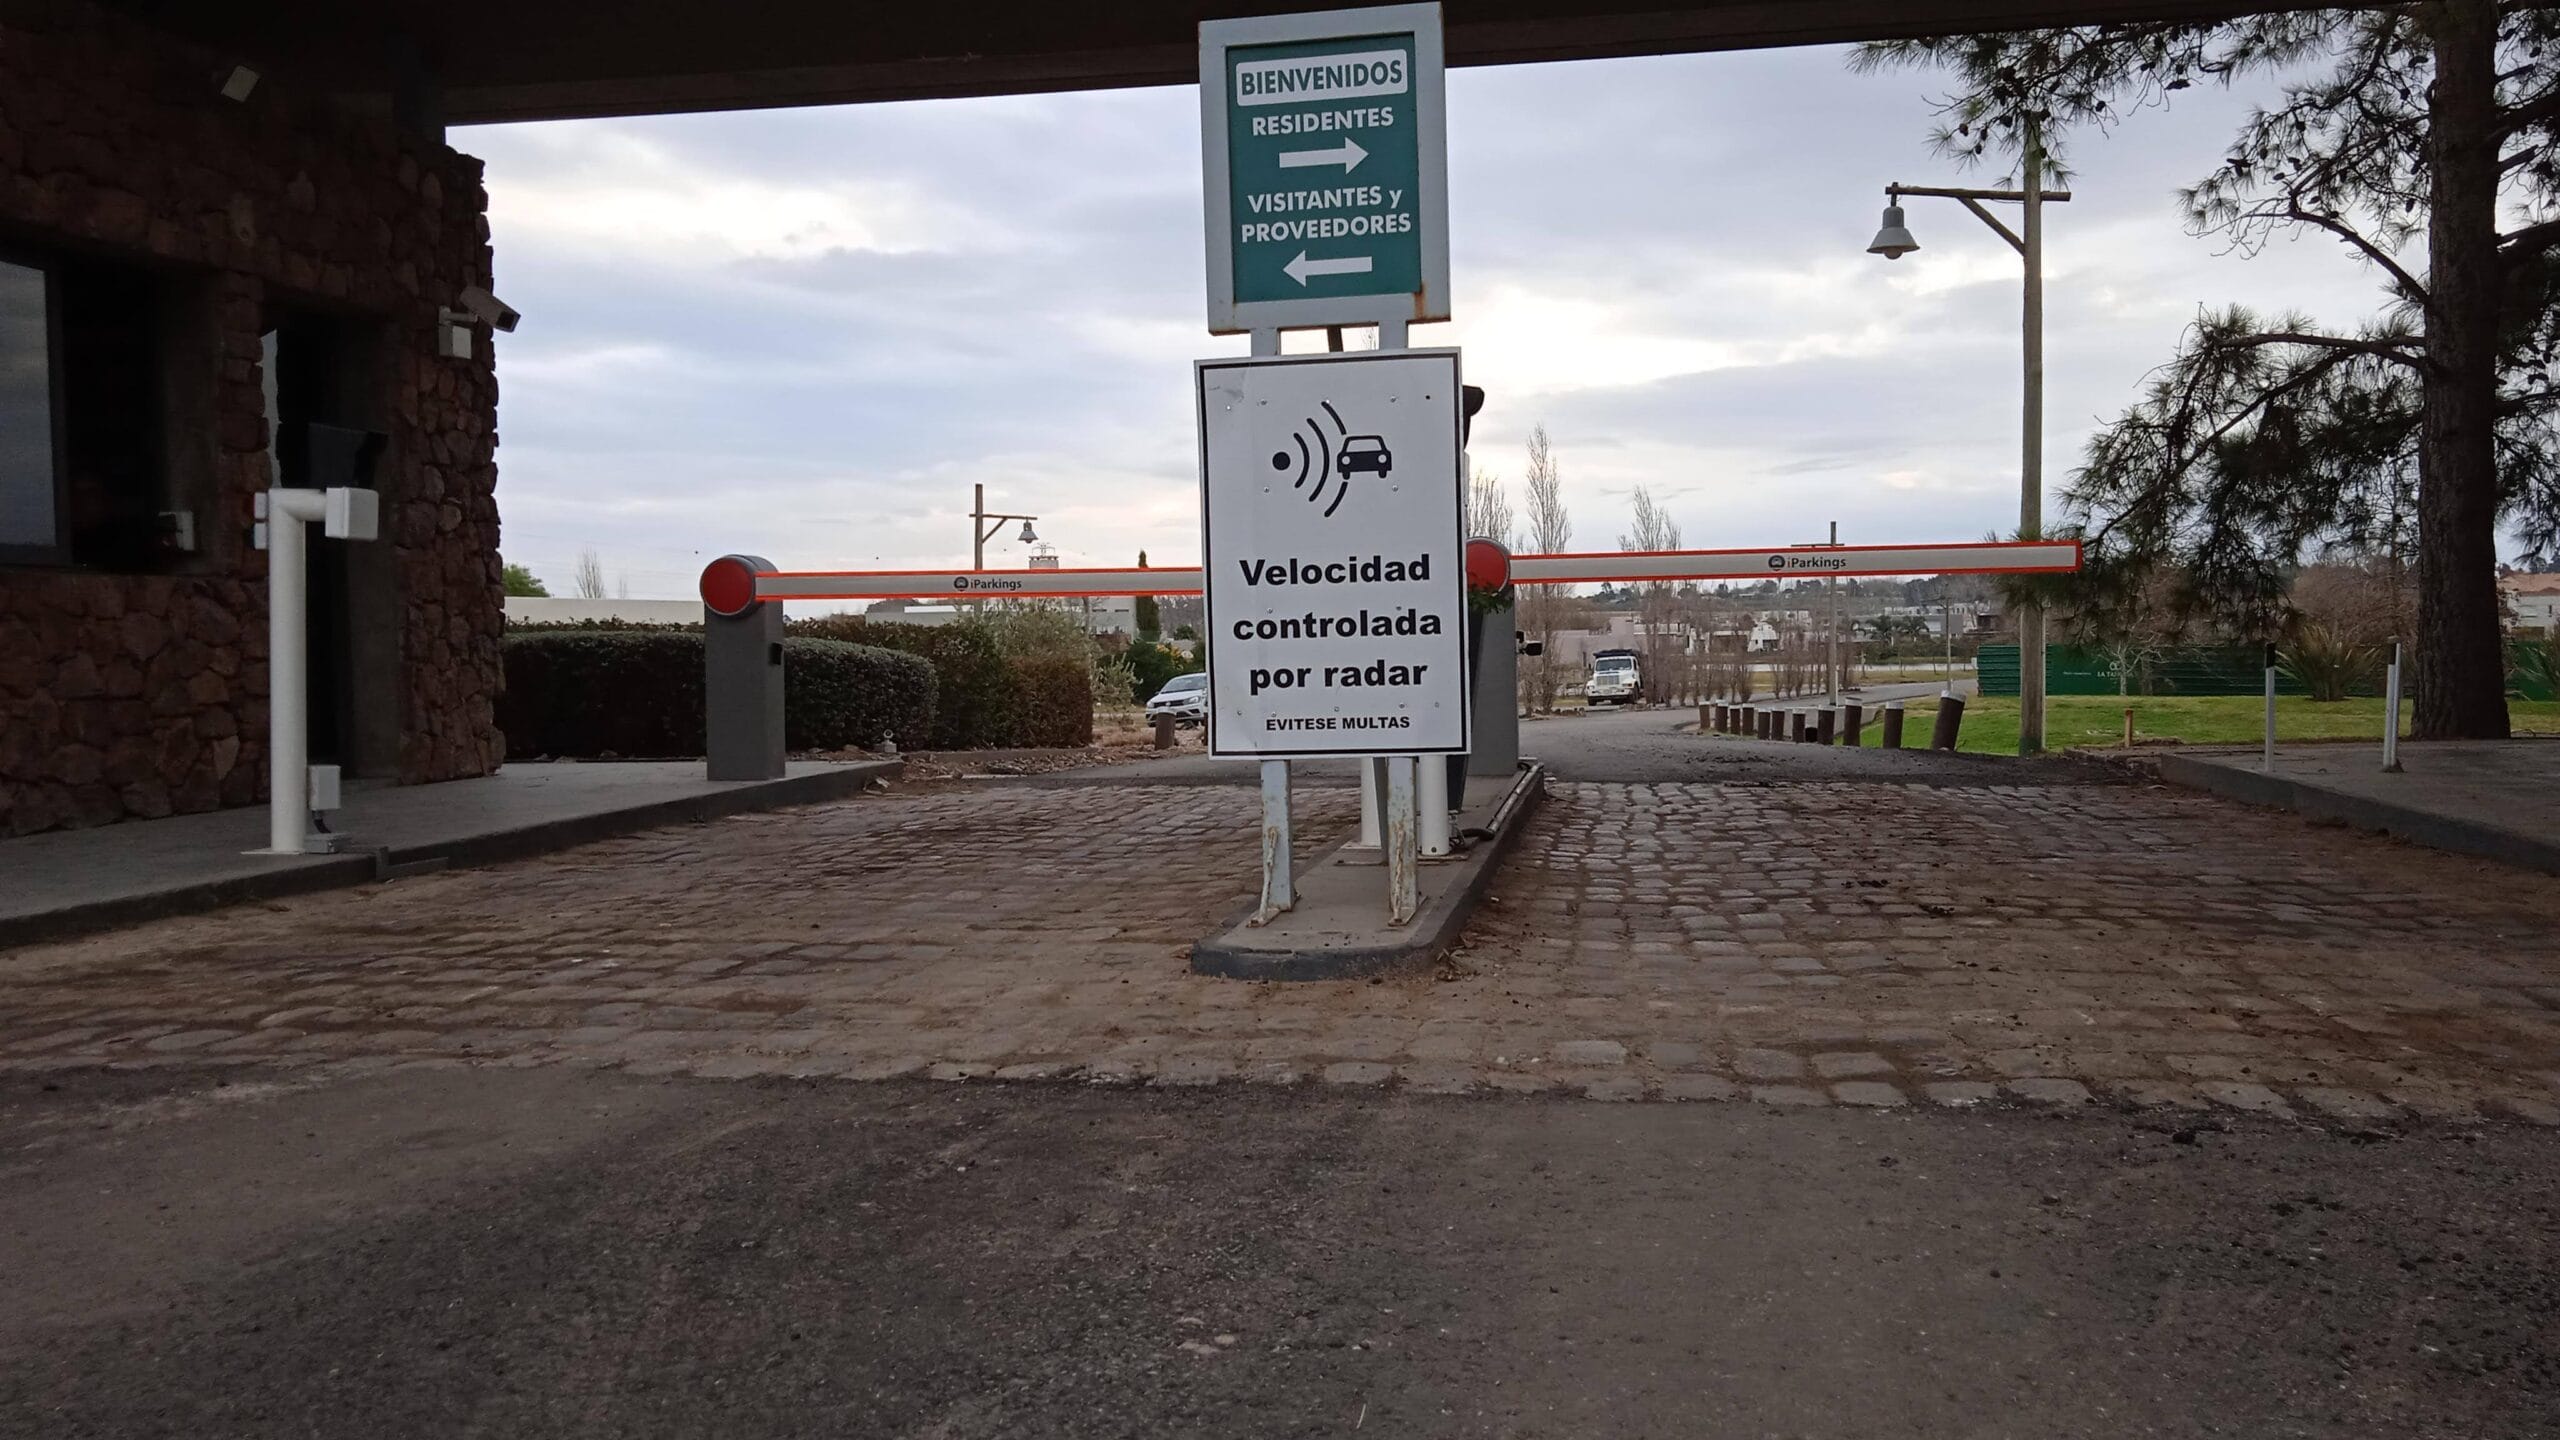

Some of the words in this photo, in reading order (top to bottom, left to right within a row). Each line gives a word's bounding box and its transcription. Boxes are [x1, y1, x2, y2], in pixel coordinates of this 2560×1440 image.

[1241, 59, 1402, 96] BIENVENIDOS
[1252, 106, 1394, 136] RESIDENTES
[1247, 185, 1382, 214] VISITANTES
[1388, 188, 1402, 209] y
[1241, 212, 1411, 243] PROVEEDORES
[1239, 553, 1431, 586] Velocidad
[1787, 556, 1846, 570] iParkings
[970, 578, 1022, 591] iParkings
[1233, 608, 1442, 640] controlada
[1250, 667, 1312, 696] por
[1324, 659, 1428, 687] radar
[1266, 718, 1337, 731] EVITESE
[1342, 716, 1410, 730] MULTAS
